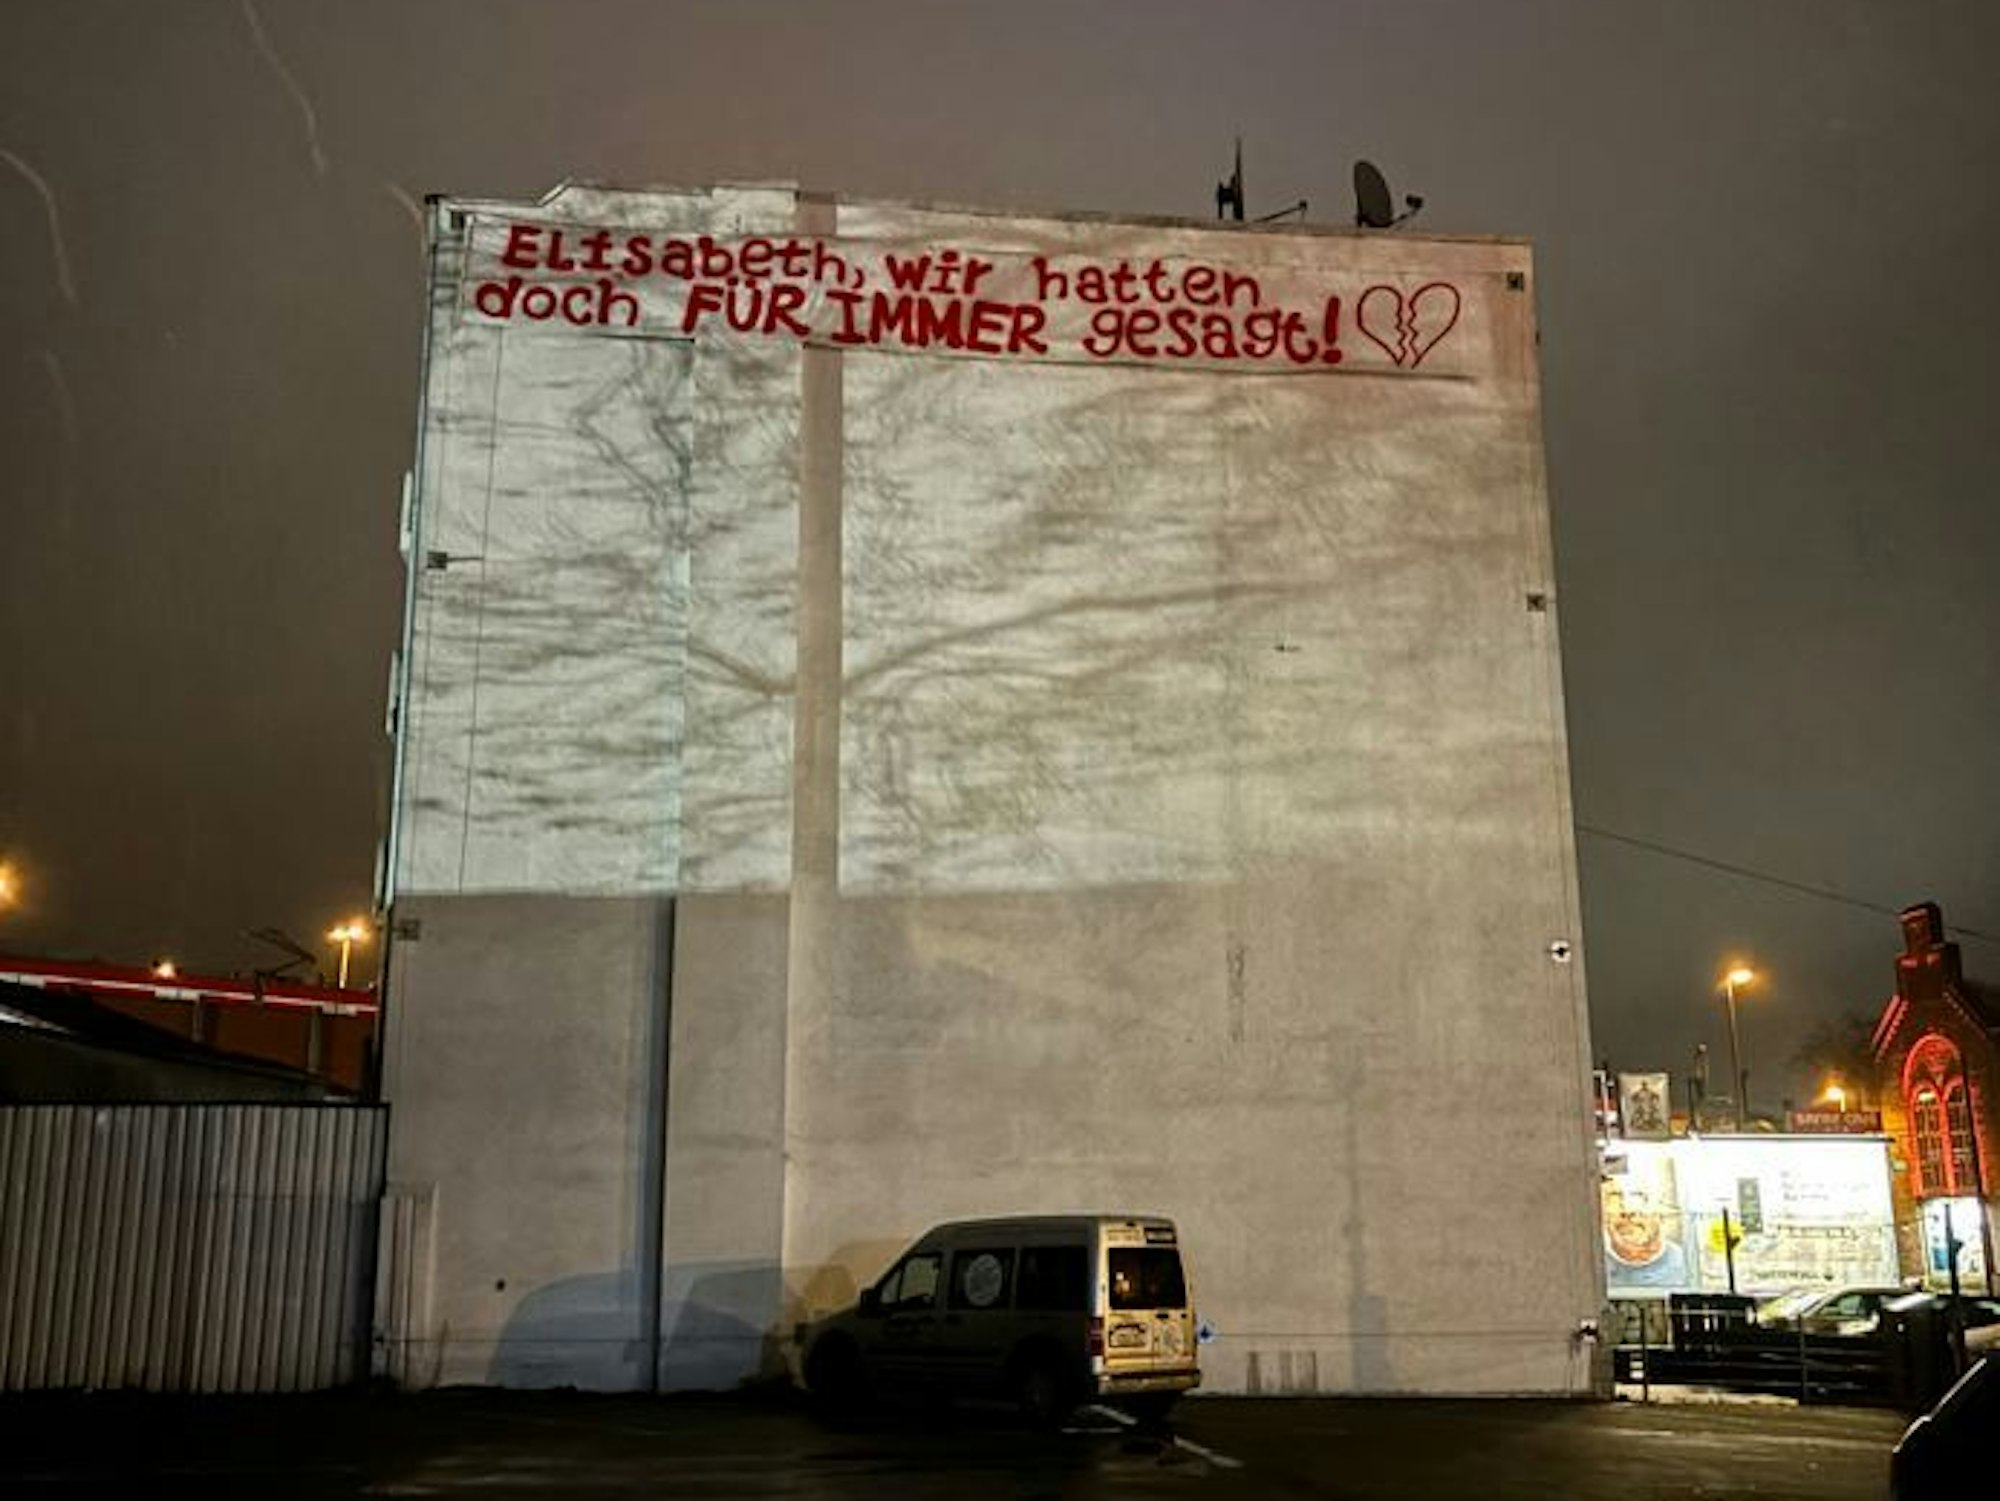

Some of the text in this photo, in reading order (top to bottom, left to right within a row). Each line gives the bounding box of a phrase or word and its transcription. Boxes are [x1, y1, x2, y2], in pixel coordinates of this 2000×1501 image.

[886, 251, 991, 295] wir
[1034, 257, 1261, 306] hatten
[475, 277, 1343, 365] doch FÜR IMMER gesagt!
